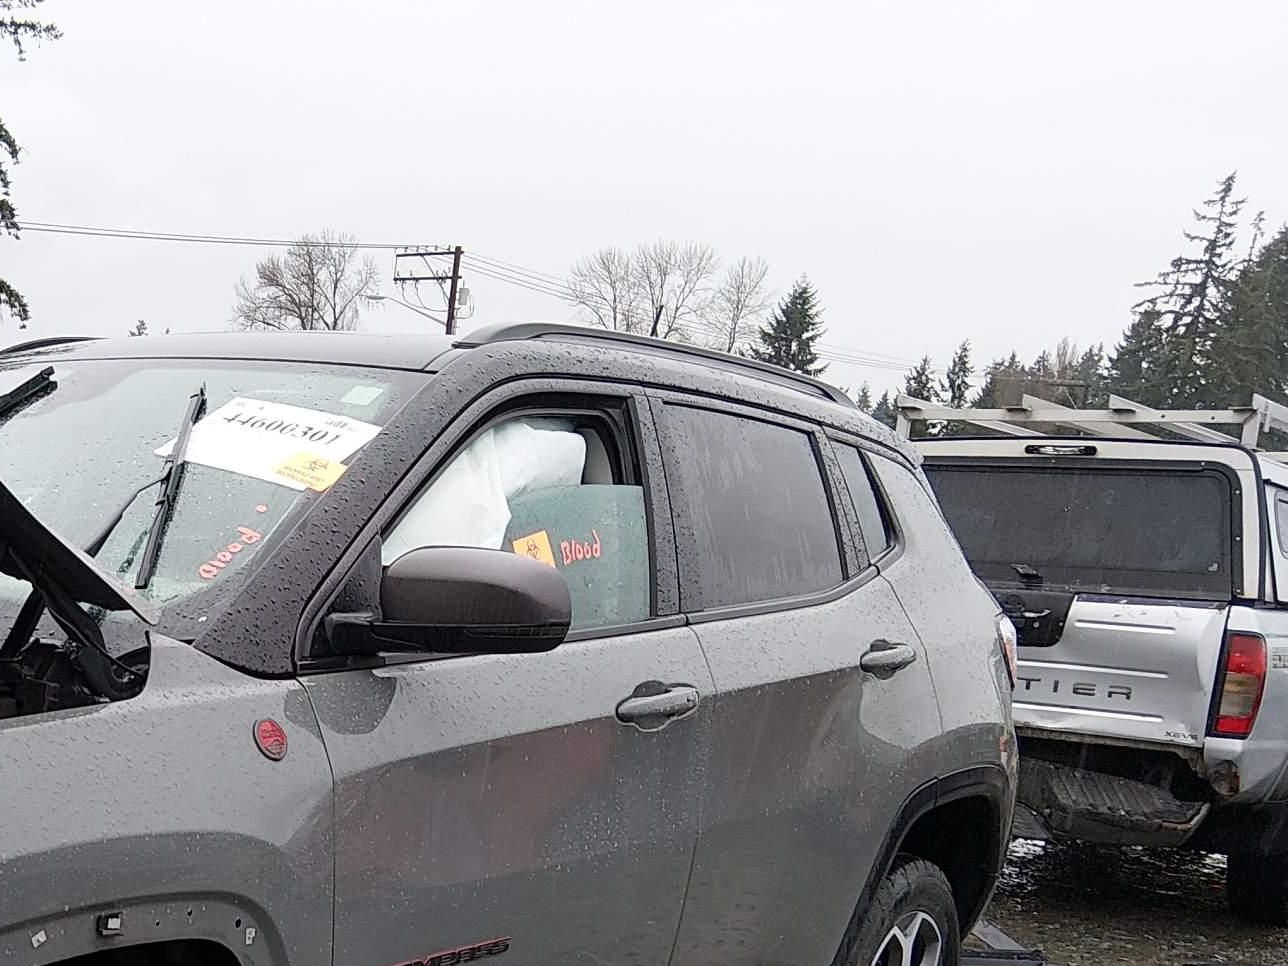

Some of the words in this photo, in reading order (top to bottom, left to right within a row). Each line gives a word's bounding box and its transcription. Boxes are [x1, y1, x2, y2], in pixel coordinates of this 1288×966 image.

[223, 412, 342, 446] 44600301
[198, 526, 262, 579] Blood
[560, 528, 601, 566] Blood
[1016, 676, 1133, 701] TIER
